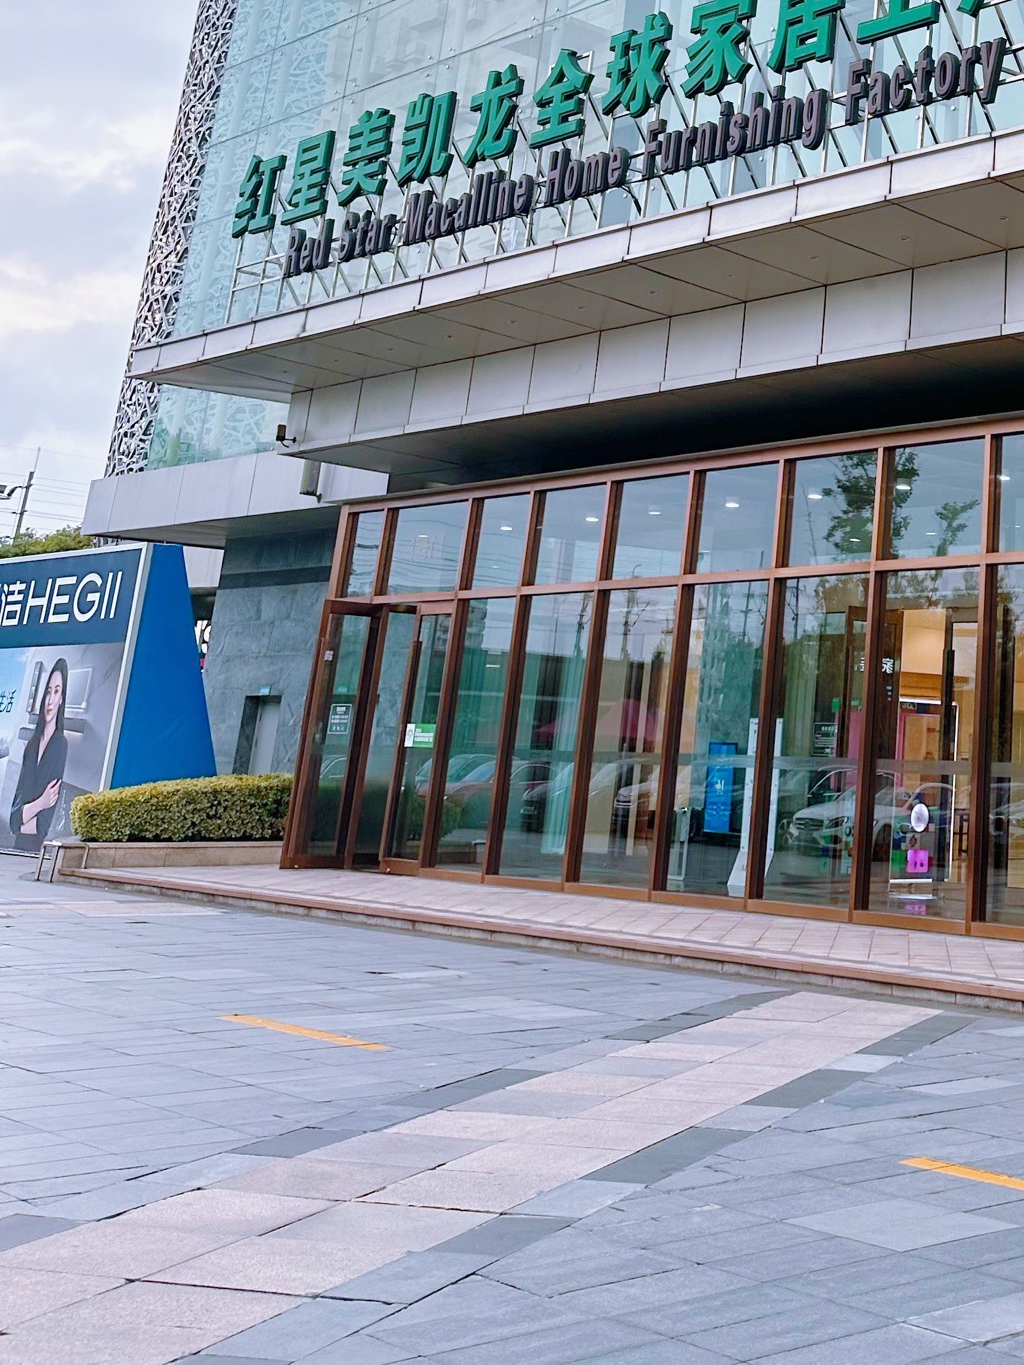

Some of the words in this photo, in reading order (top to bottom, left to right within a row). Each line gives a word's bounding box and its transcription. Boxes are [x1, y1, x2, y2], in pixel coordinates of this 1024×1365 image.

[283, 218, 335, 278] Red
[337, 210, 398, 263] Star
[402, 169, 535, 246] Macalline
[543, 146, 630, 205] Home
[641, 85, 829, 180] Furnishing
[844, 36, 1007, 125] Factory
[0, 580, 26, 626] 洁
[23, 571, 122, 625] HEGII
